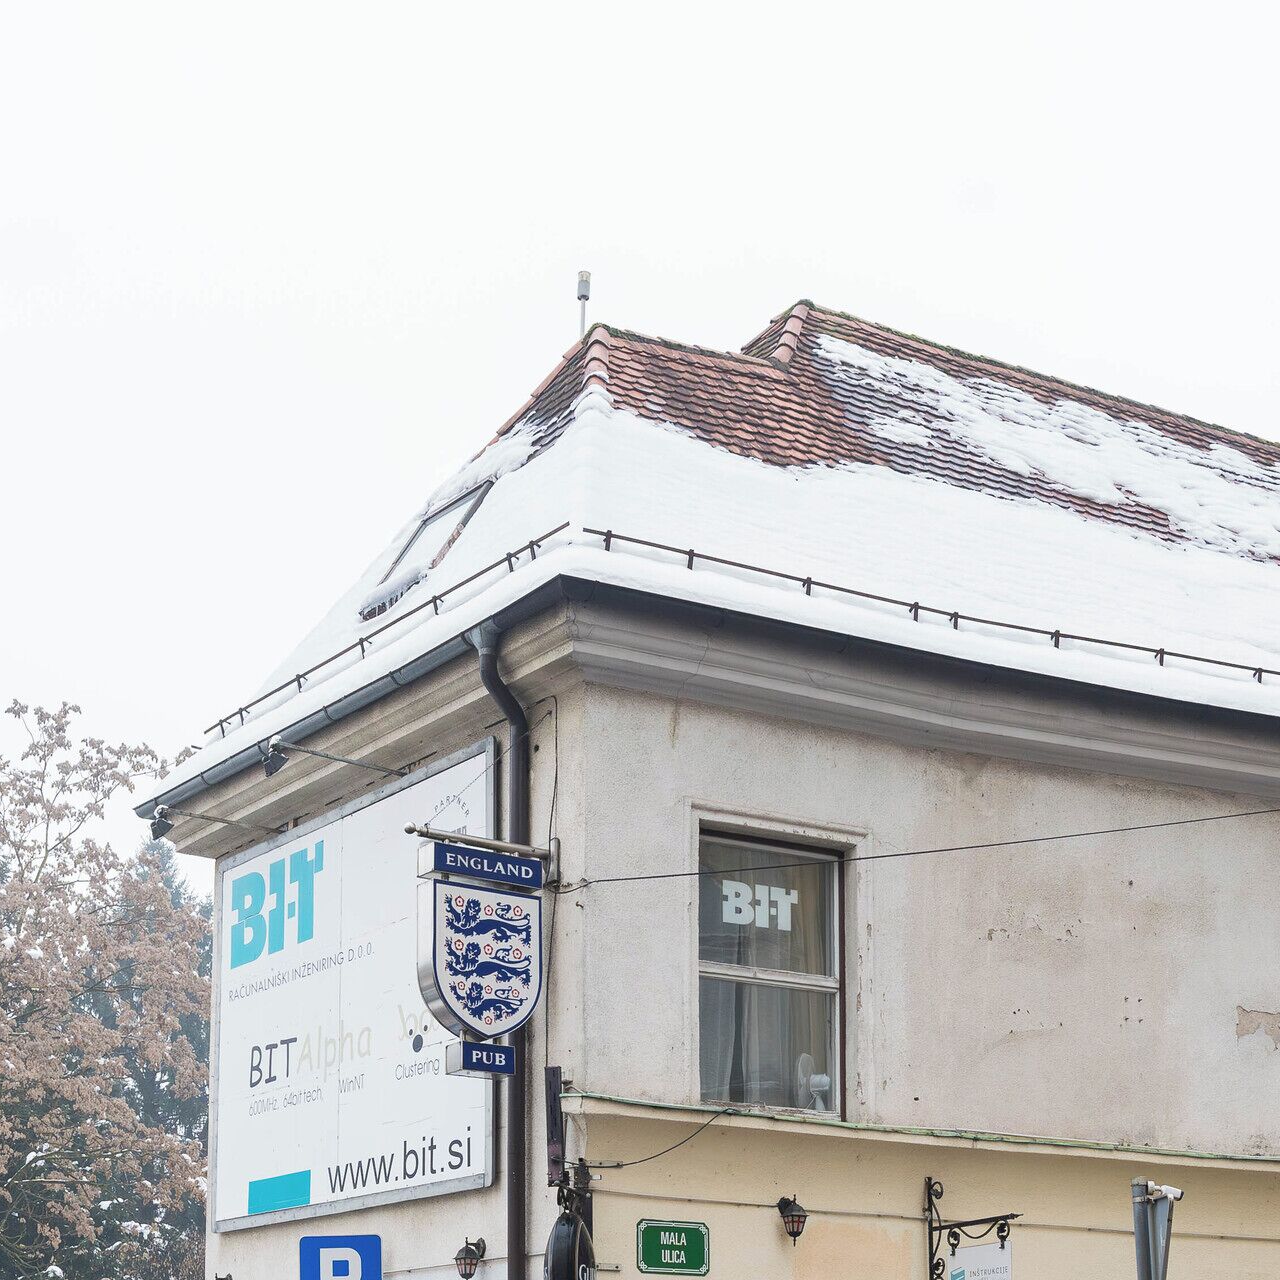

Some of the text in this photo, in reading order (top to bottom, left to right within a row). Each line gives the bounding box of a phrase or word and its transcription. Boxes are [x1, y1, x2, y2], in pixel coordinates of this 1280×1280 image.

[445, 852, 534, 879] ENGLAND
[231, 840, 324, 970] BIT
[722, 880, 798, 931] BIT
[395, 1059, 440, 1081] Clustering
[471, 1050, 506, 1067] PUB
[328, 1125, 472, 1194] www.bit.si
[660, 1231, 687, 1246] MALA
[661, 1249, 686, 1264] ULICA
